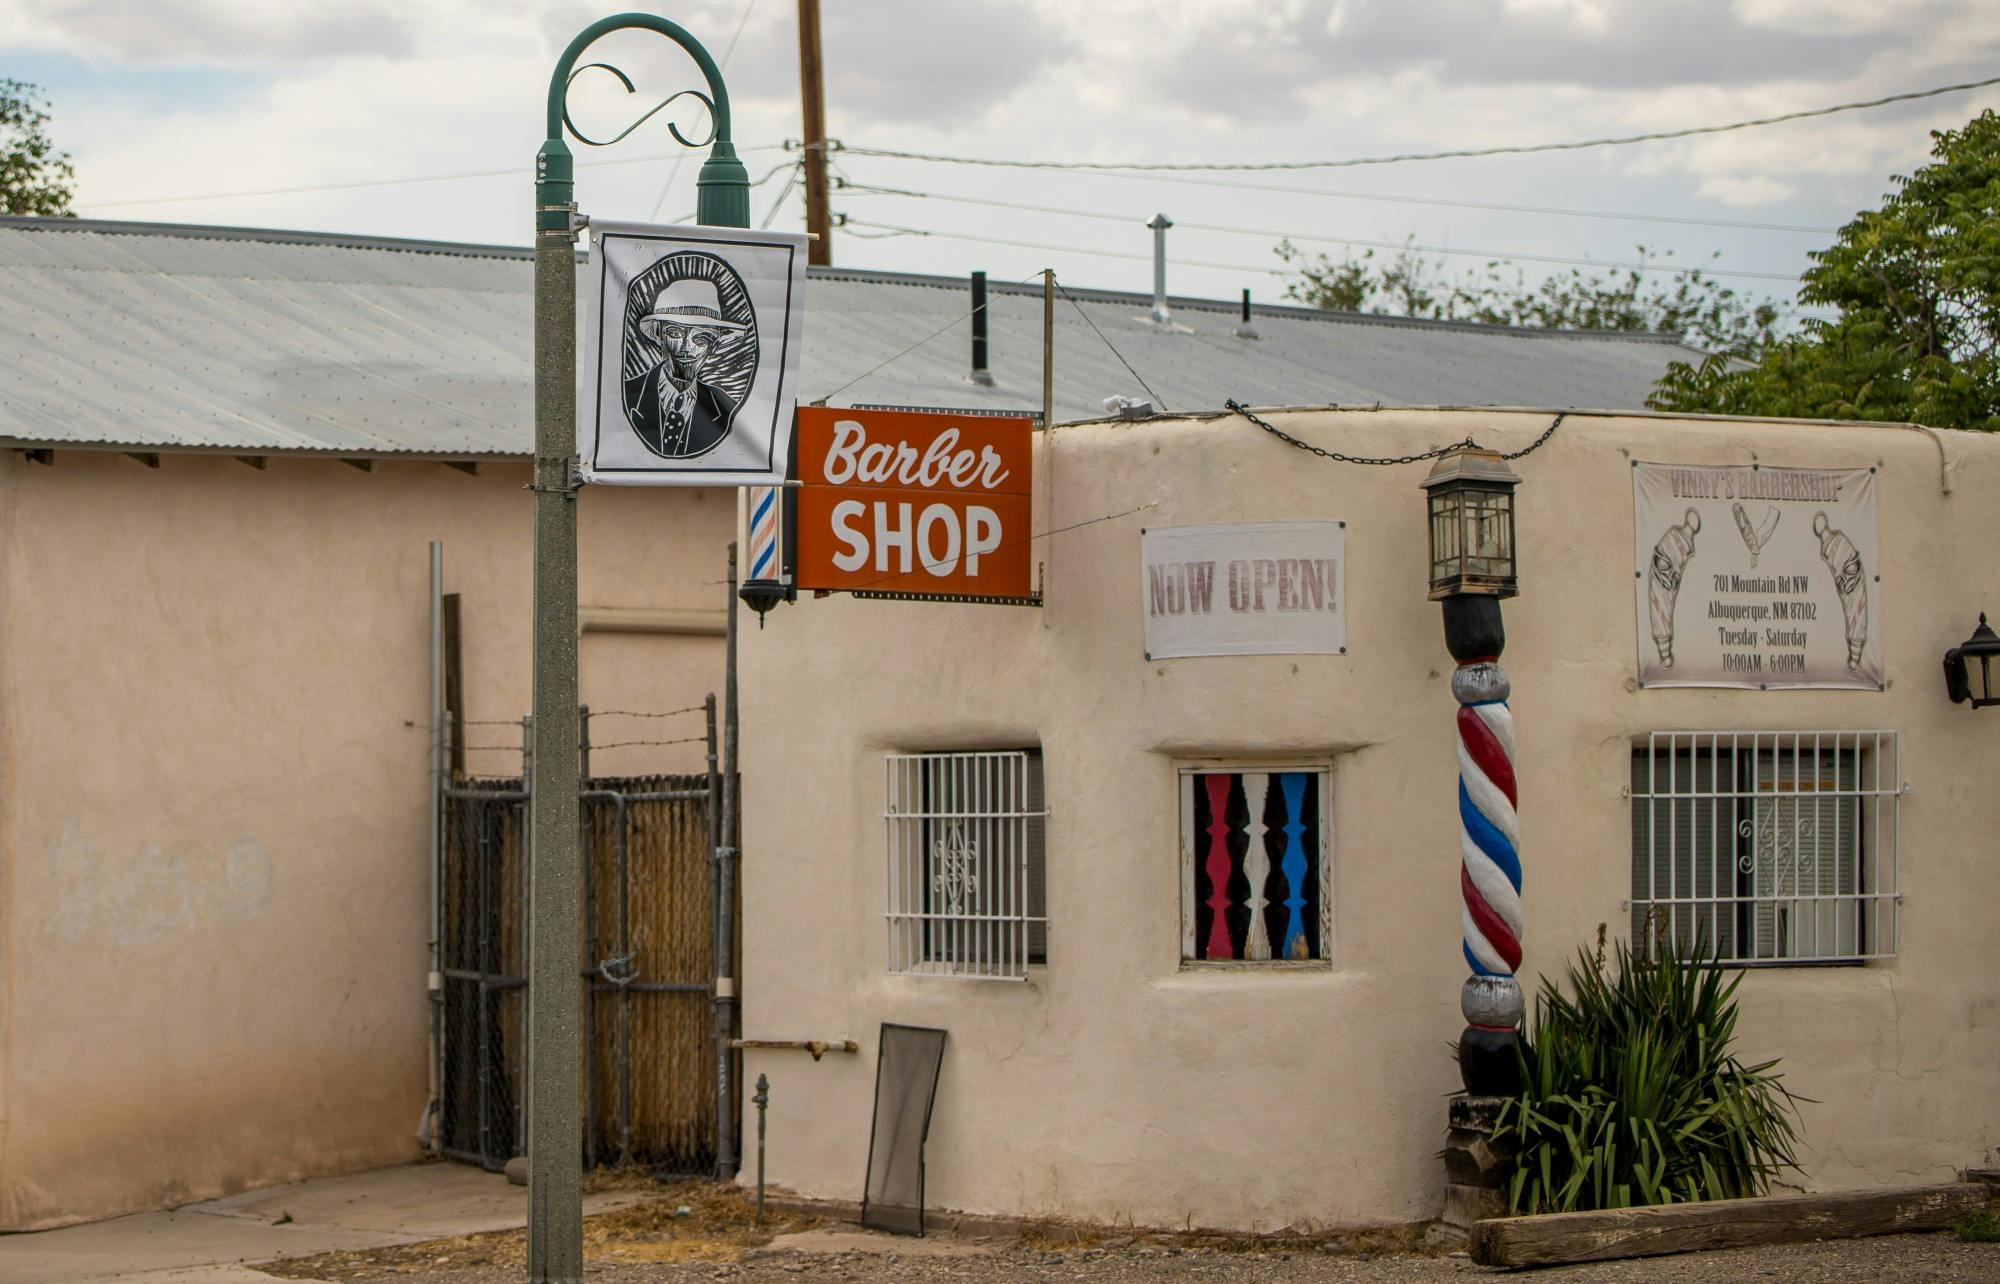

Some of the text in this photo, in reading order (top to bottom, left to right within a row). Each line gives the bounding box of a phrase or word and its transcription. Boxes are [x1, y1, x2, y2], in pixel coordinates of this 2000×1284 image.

[823, 420, 1010, 489] Barber
[831, 500, 1003, 577] SHOP
[1148, 558, 1338, 618] NOW OPEN!
[1713, 574, 1809, 594] 701 Mountain Rd NW
[1708, 600, 1816, 622] Albuquerque, NM 87102
[1718, 626, 1757, 648] Tuesday
[1766, 627, 1807, 649] Saturday
[1722, 653, 1762, 673] 10:00AM
[1770, 654, 1805, 673] 6:00PM
